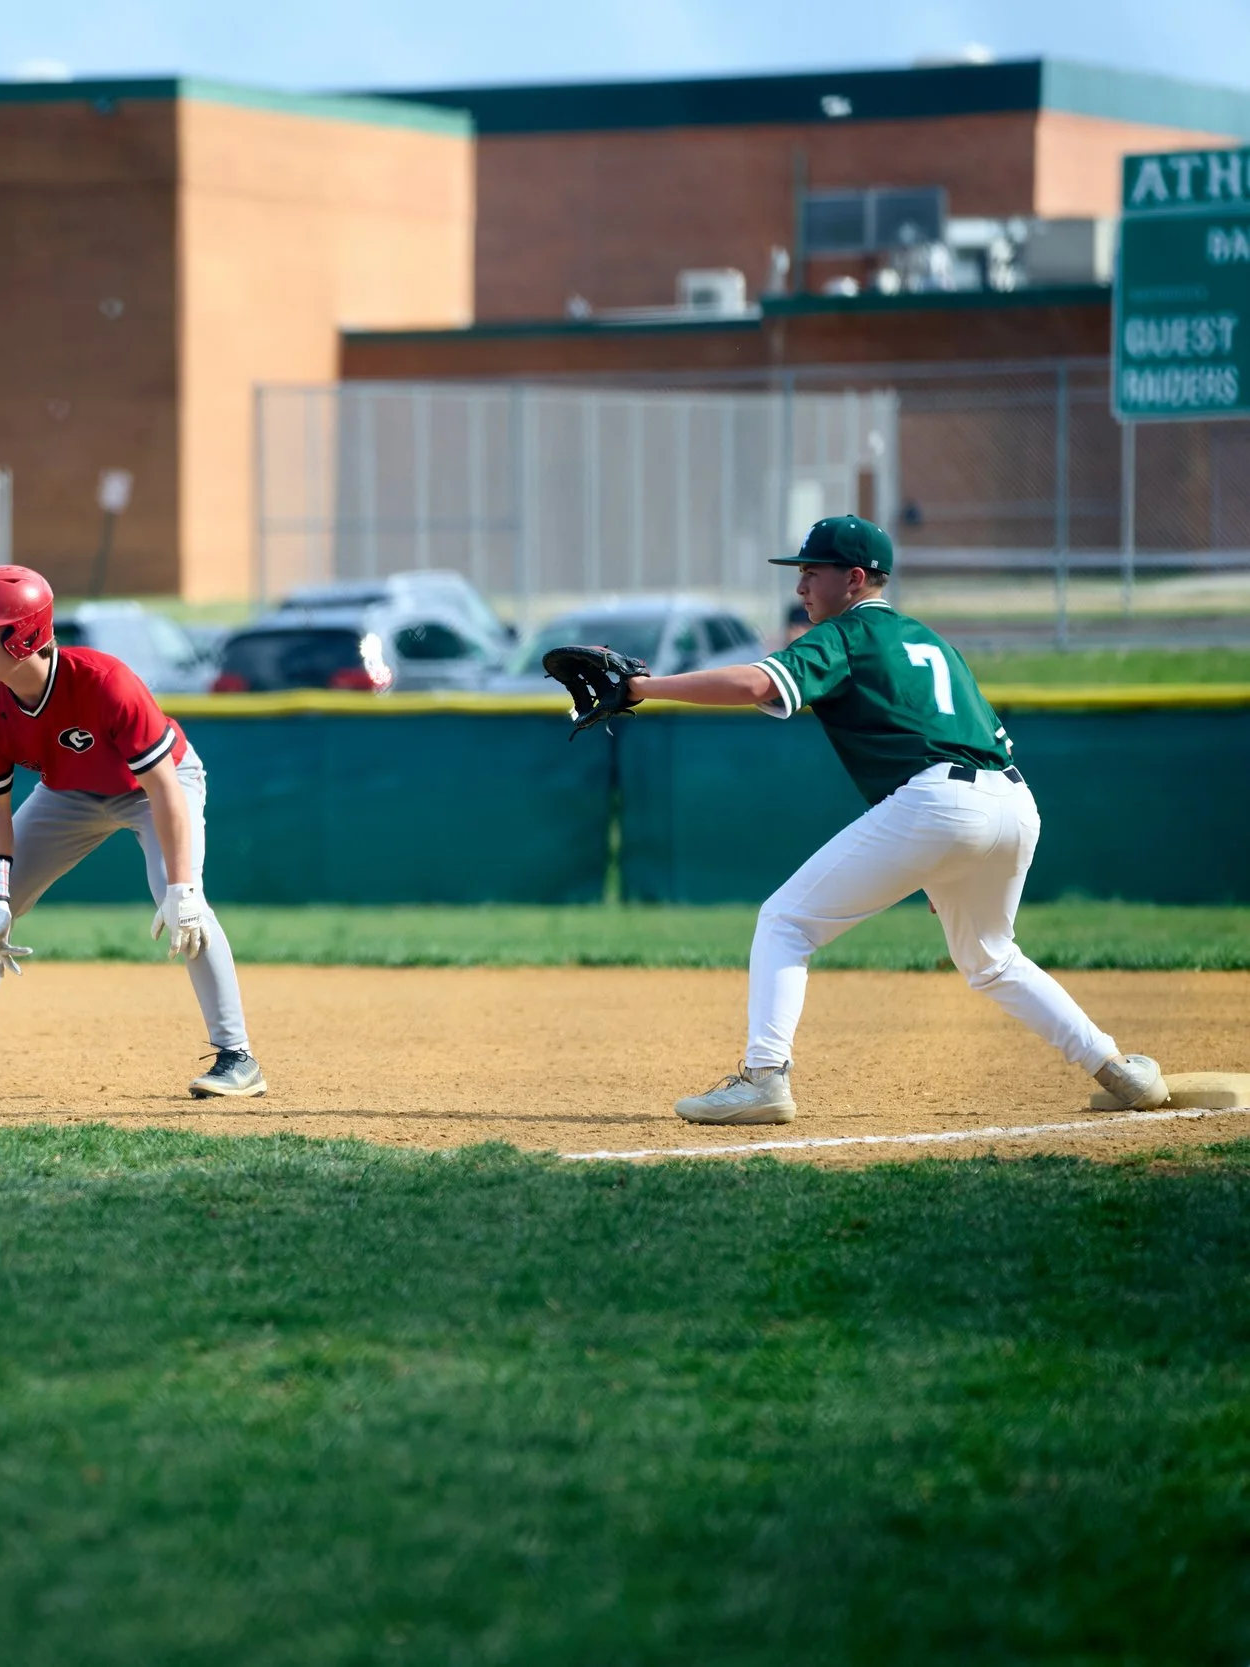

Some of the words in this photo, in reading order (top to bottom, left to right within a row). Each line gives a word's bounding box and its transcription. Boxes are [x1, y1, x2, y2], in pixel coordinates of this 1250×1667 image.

[1130, 153, 1250, 204] ATH
[1124, 315, 1238, 358] GUEST
[902, 641, 956, 716] 7
